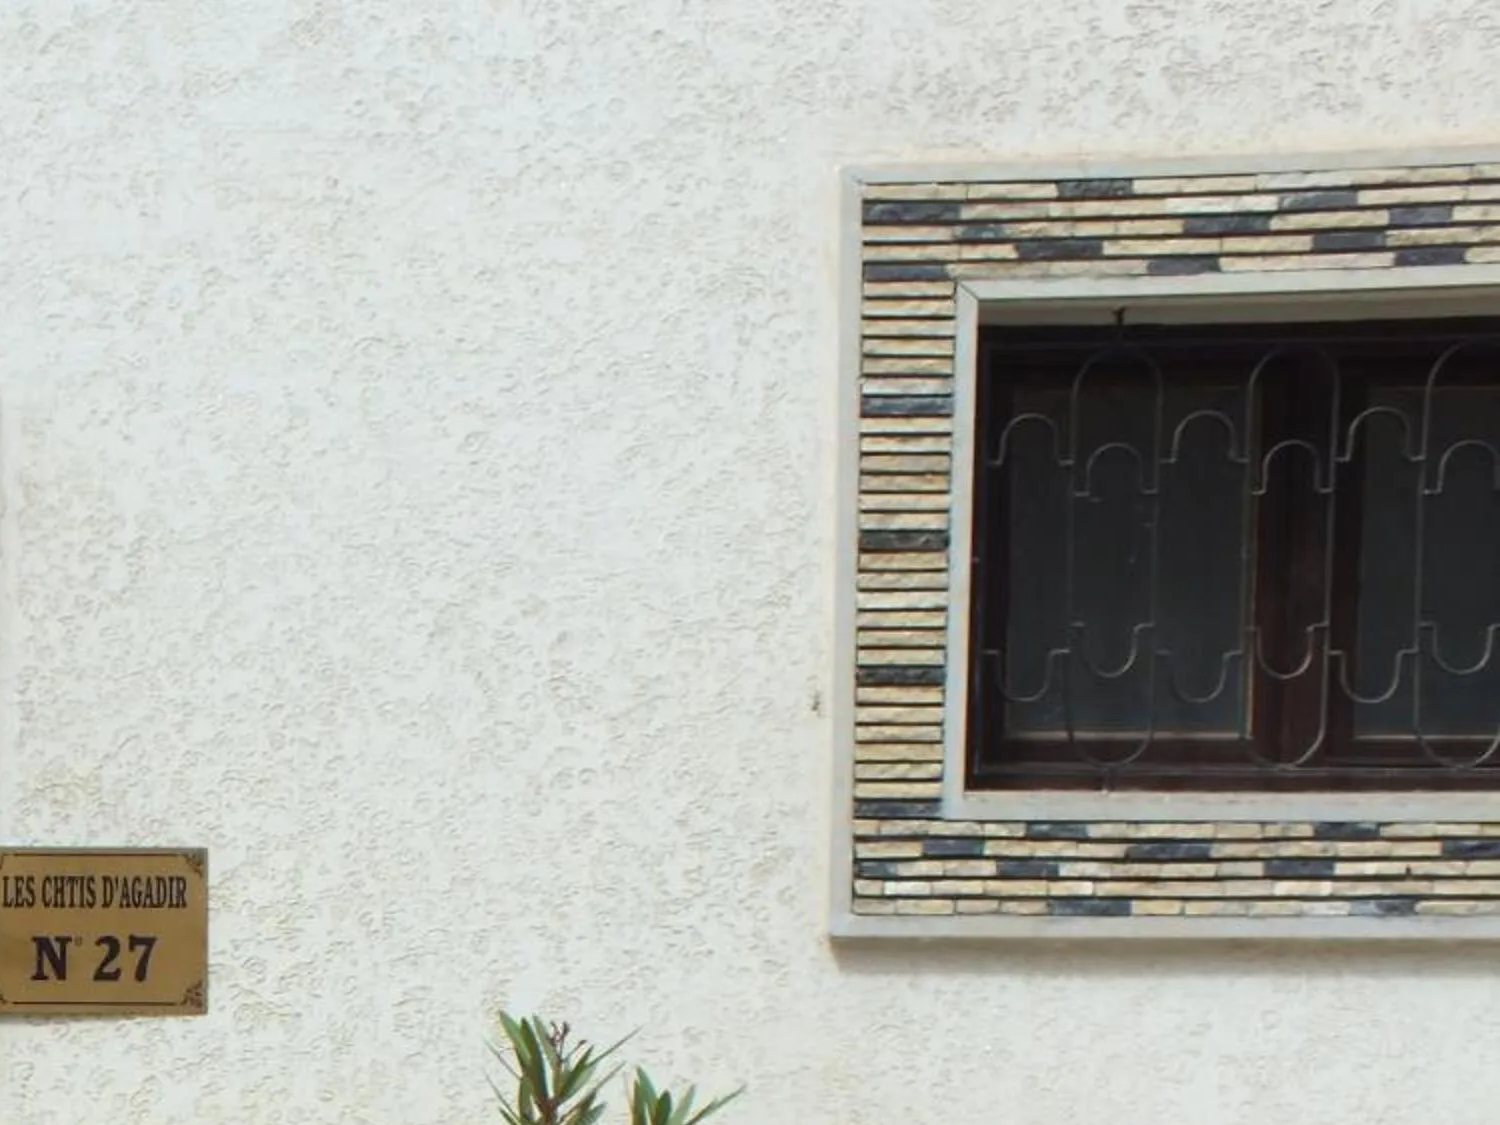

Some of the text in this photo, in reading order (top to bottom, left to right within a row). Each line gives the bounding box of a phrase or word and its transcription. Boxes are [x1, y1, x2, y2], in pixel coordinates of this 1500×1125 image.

[2, 875, 188, 909] LES CHTIS D'AGADIR
[93, 934, 158, 983] 27
